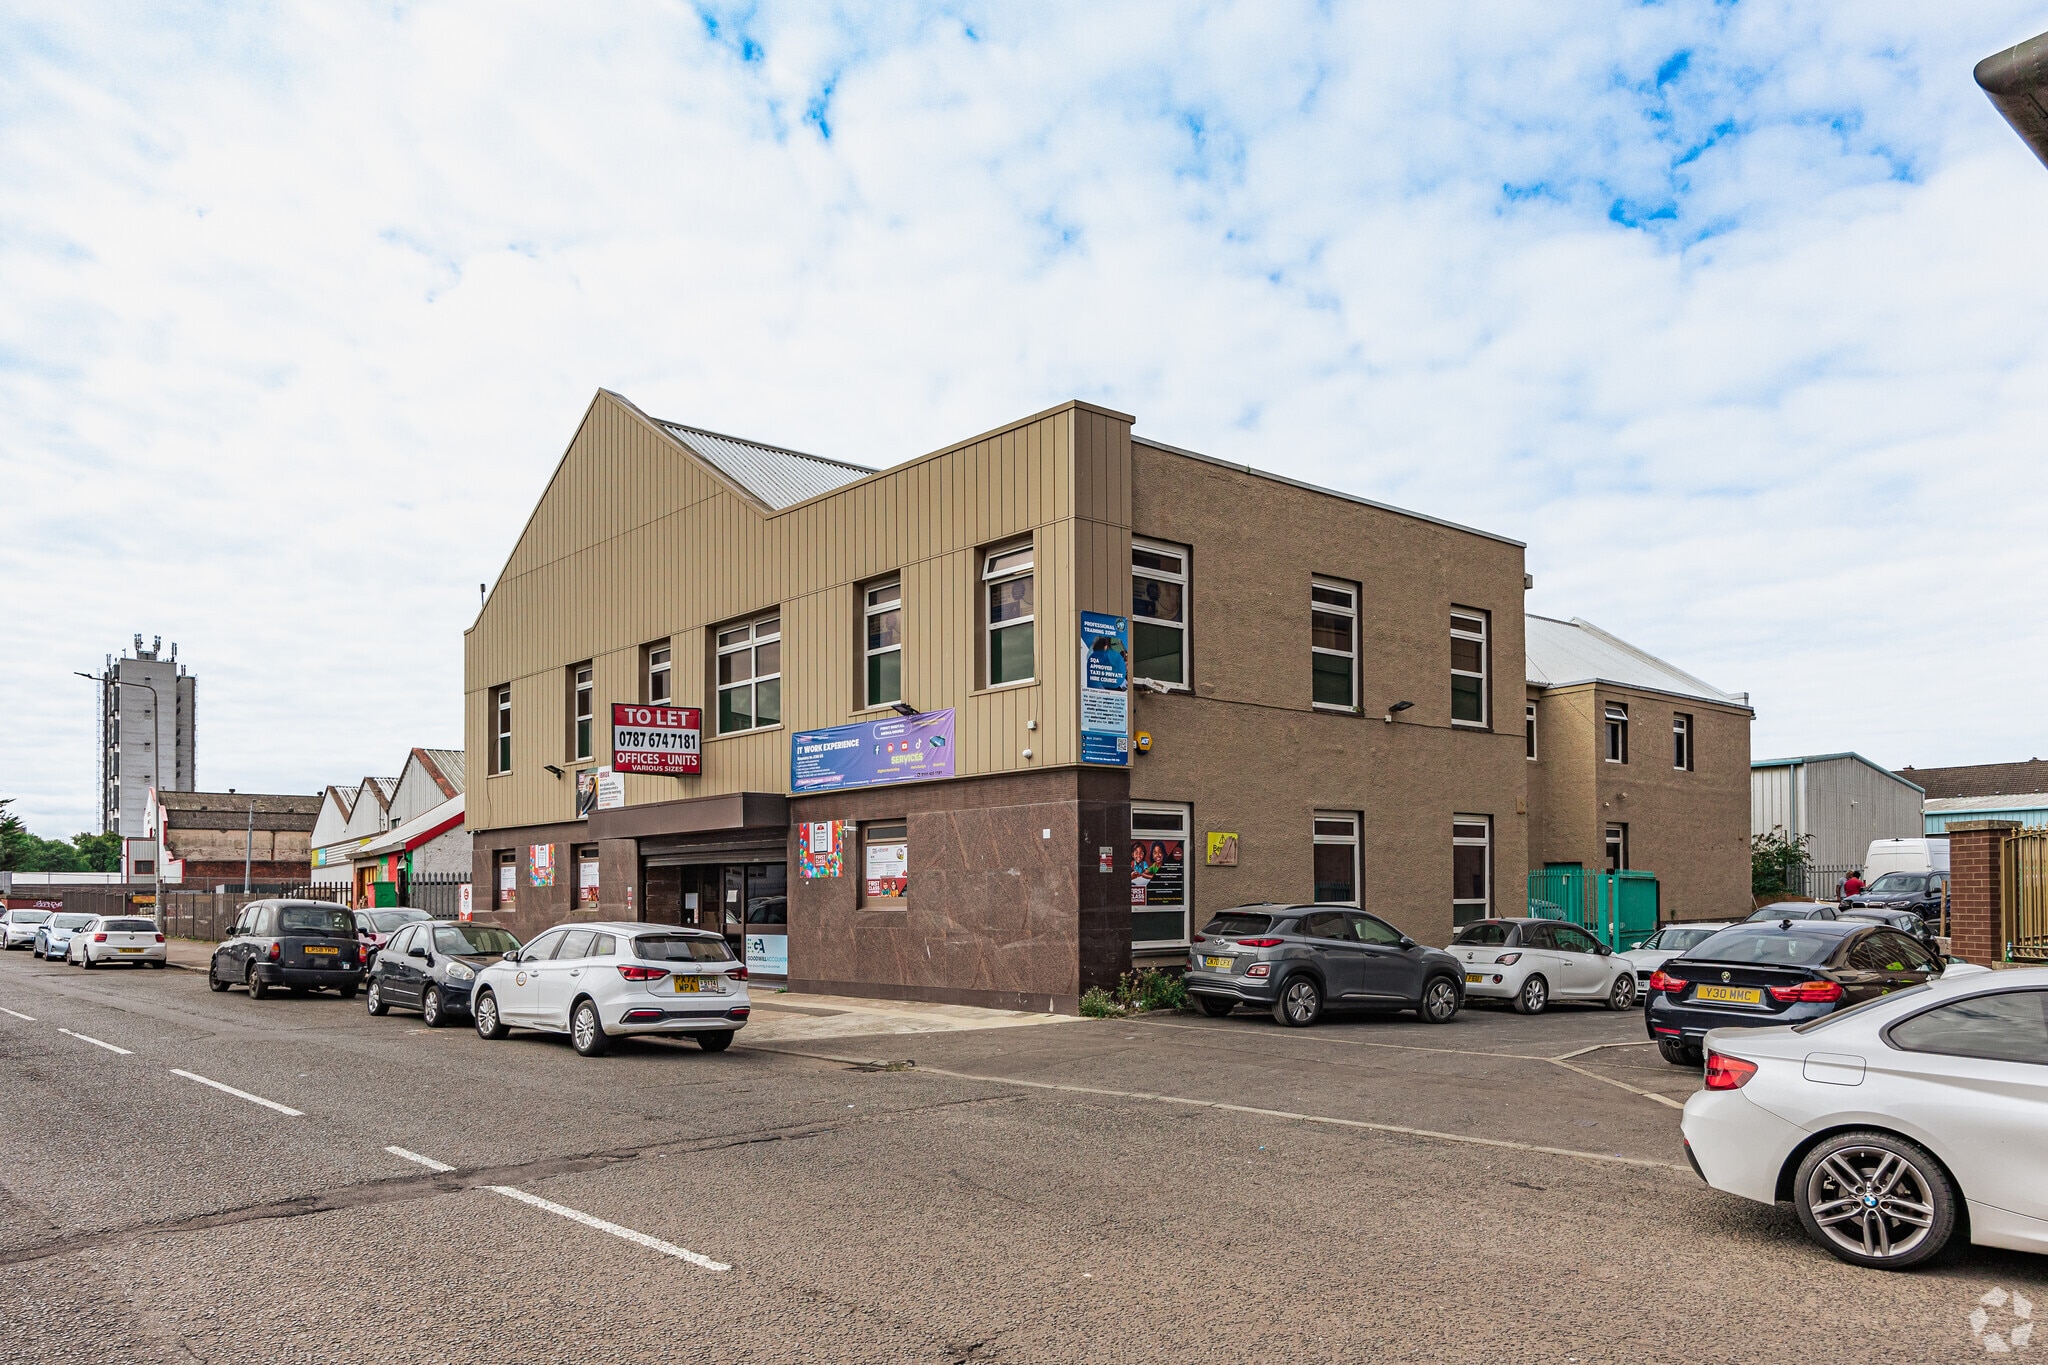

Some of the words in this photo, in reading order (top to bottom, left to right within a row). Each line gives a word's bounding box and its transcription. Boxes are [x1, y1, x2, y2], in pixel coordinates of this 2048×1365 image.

[1084, 621, 1115, 630] PROFESSIONAL
[624, 708, 651, 724] TO
[656, 710, 689, 726] LET
[619, 731, 646, 747] 0787
[648, 732, 668, 748] 674
[671, 734, 696, 749] 7181
[804, 744, 822, 753] WORK
[823, 739, 859, 751] EXPERIENCE
[617, 752, 659, 764] OFFICES
[667, 754, 697, 765] UNITS
[891, 753, 923, 764] SERVICES
[1706, 988, 1726, 998] Y30
[1730, 990, 1751, 1000] MMC
